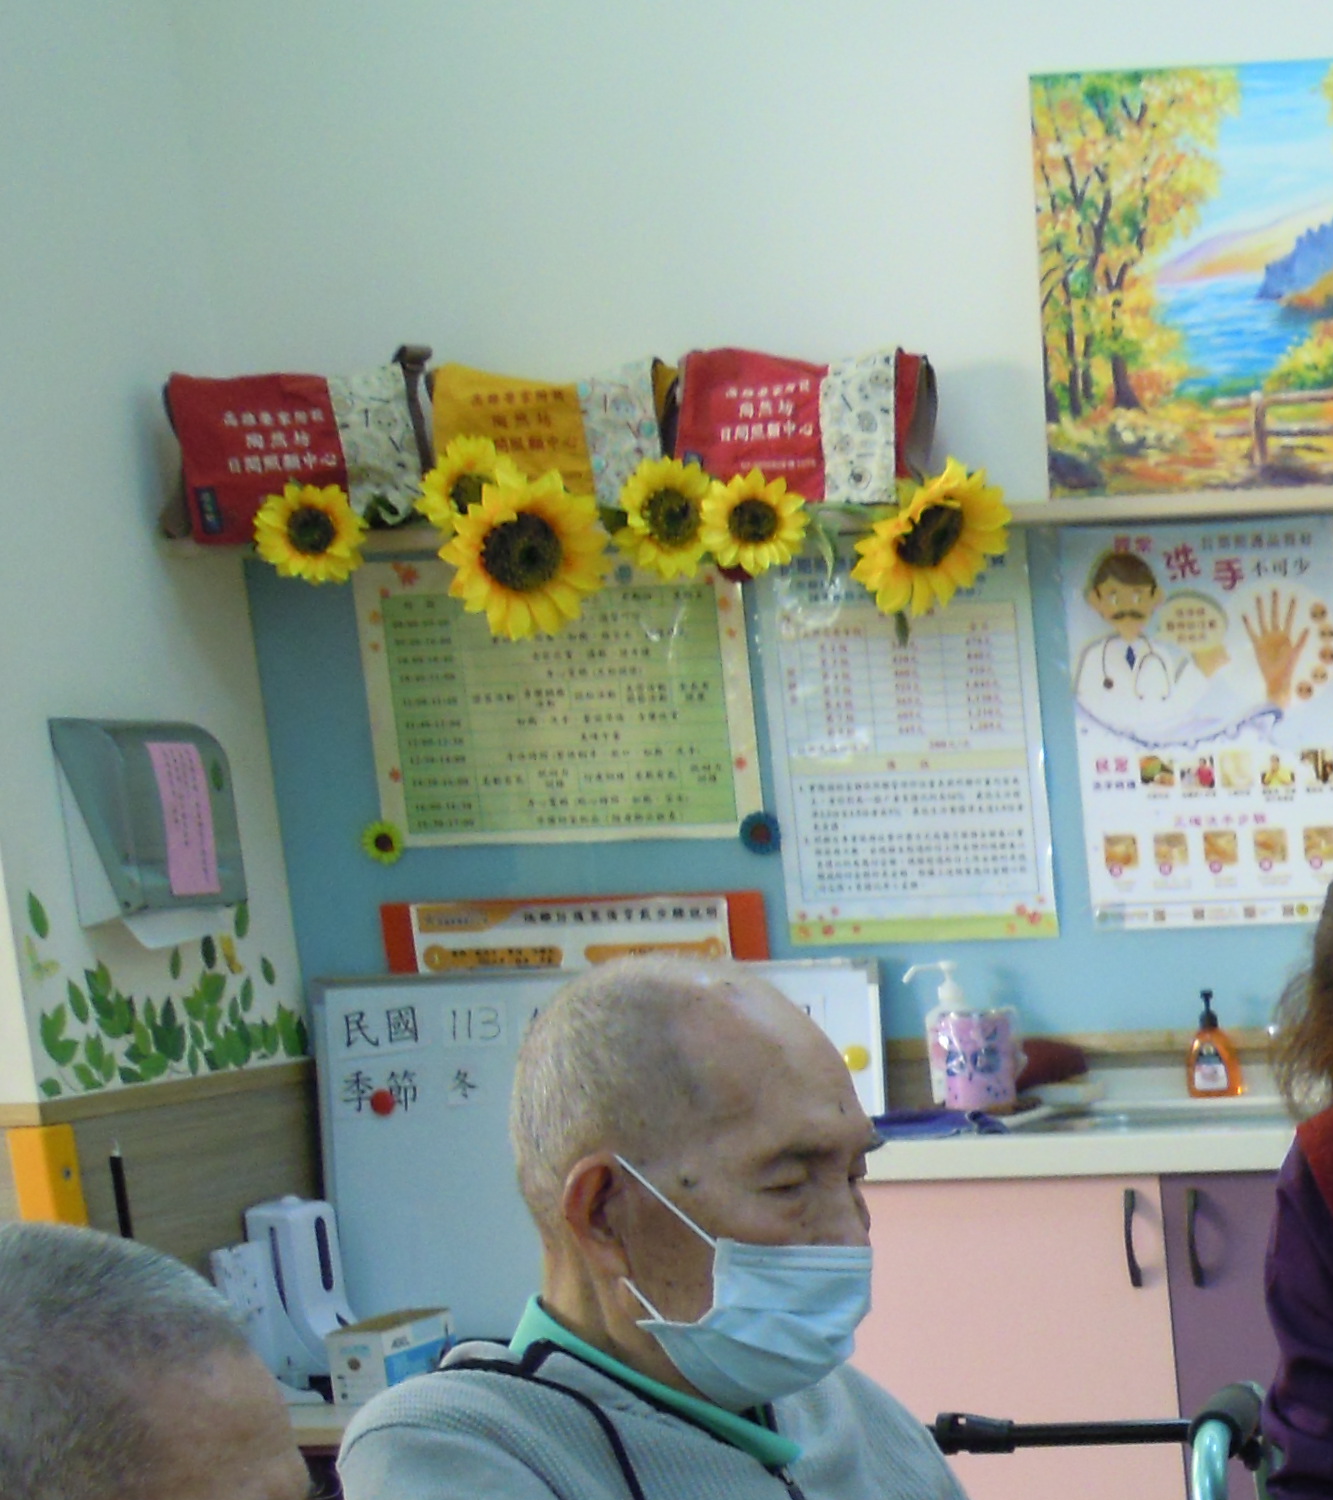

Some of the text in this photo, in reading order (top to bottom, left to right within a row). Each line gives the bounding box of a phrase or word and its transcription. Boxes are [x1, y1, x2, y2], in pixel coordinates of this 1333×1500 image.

[1252, 556, 1312, 579] 不可少
[343, 1005, 502, 1050] 民國 113
[342, 1067, 478, 1113] 季節 冬
